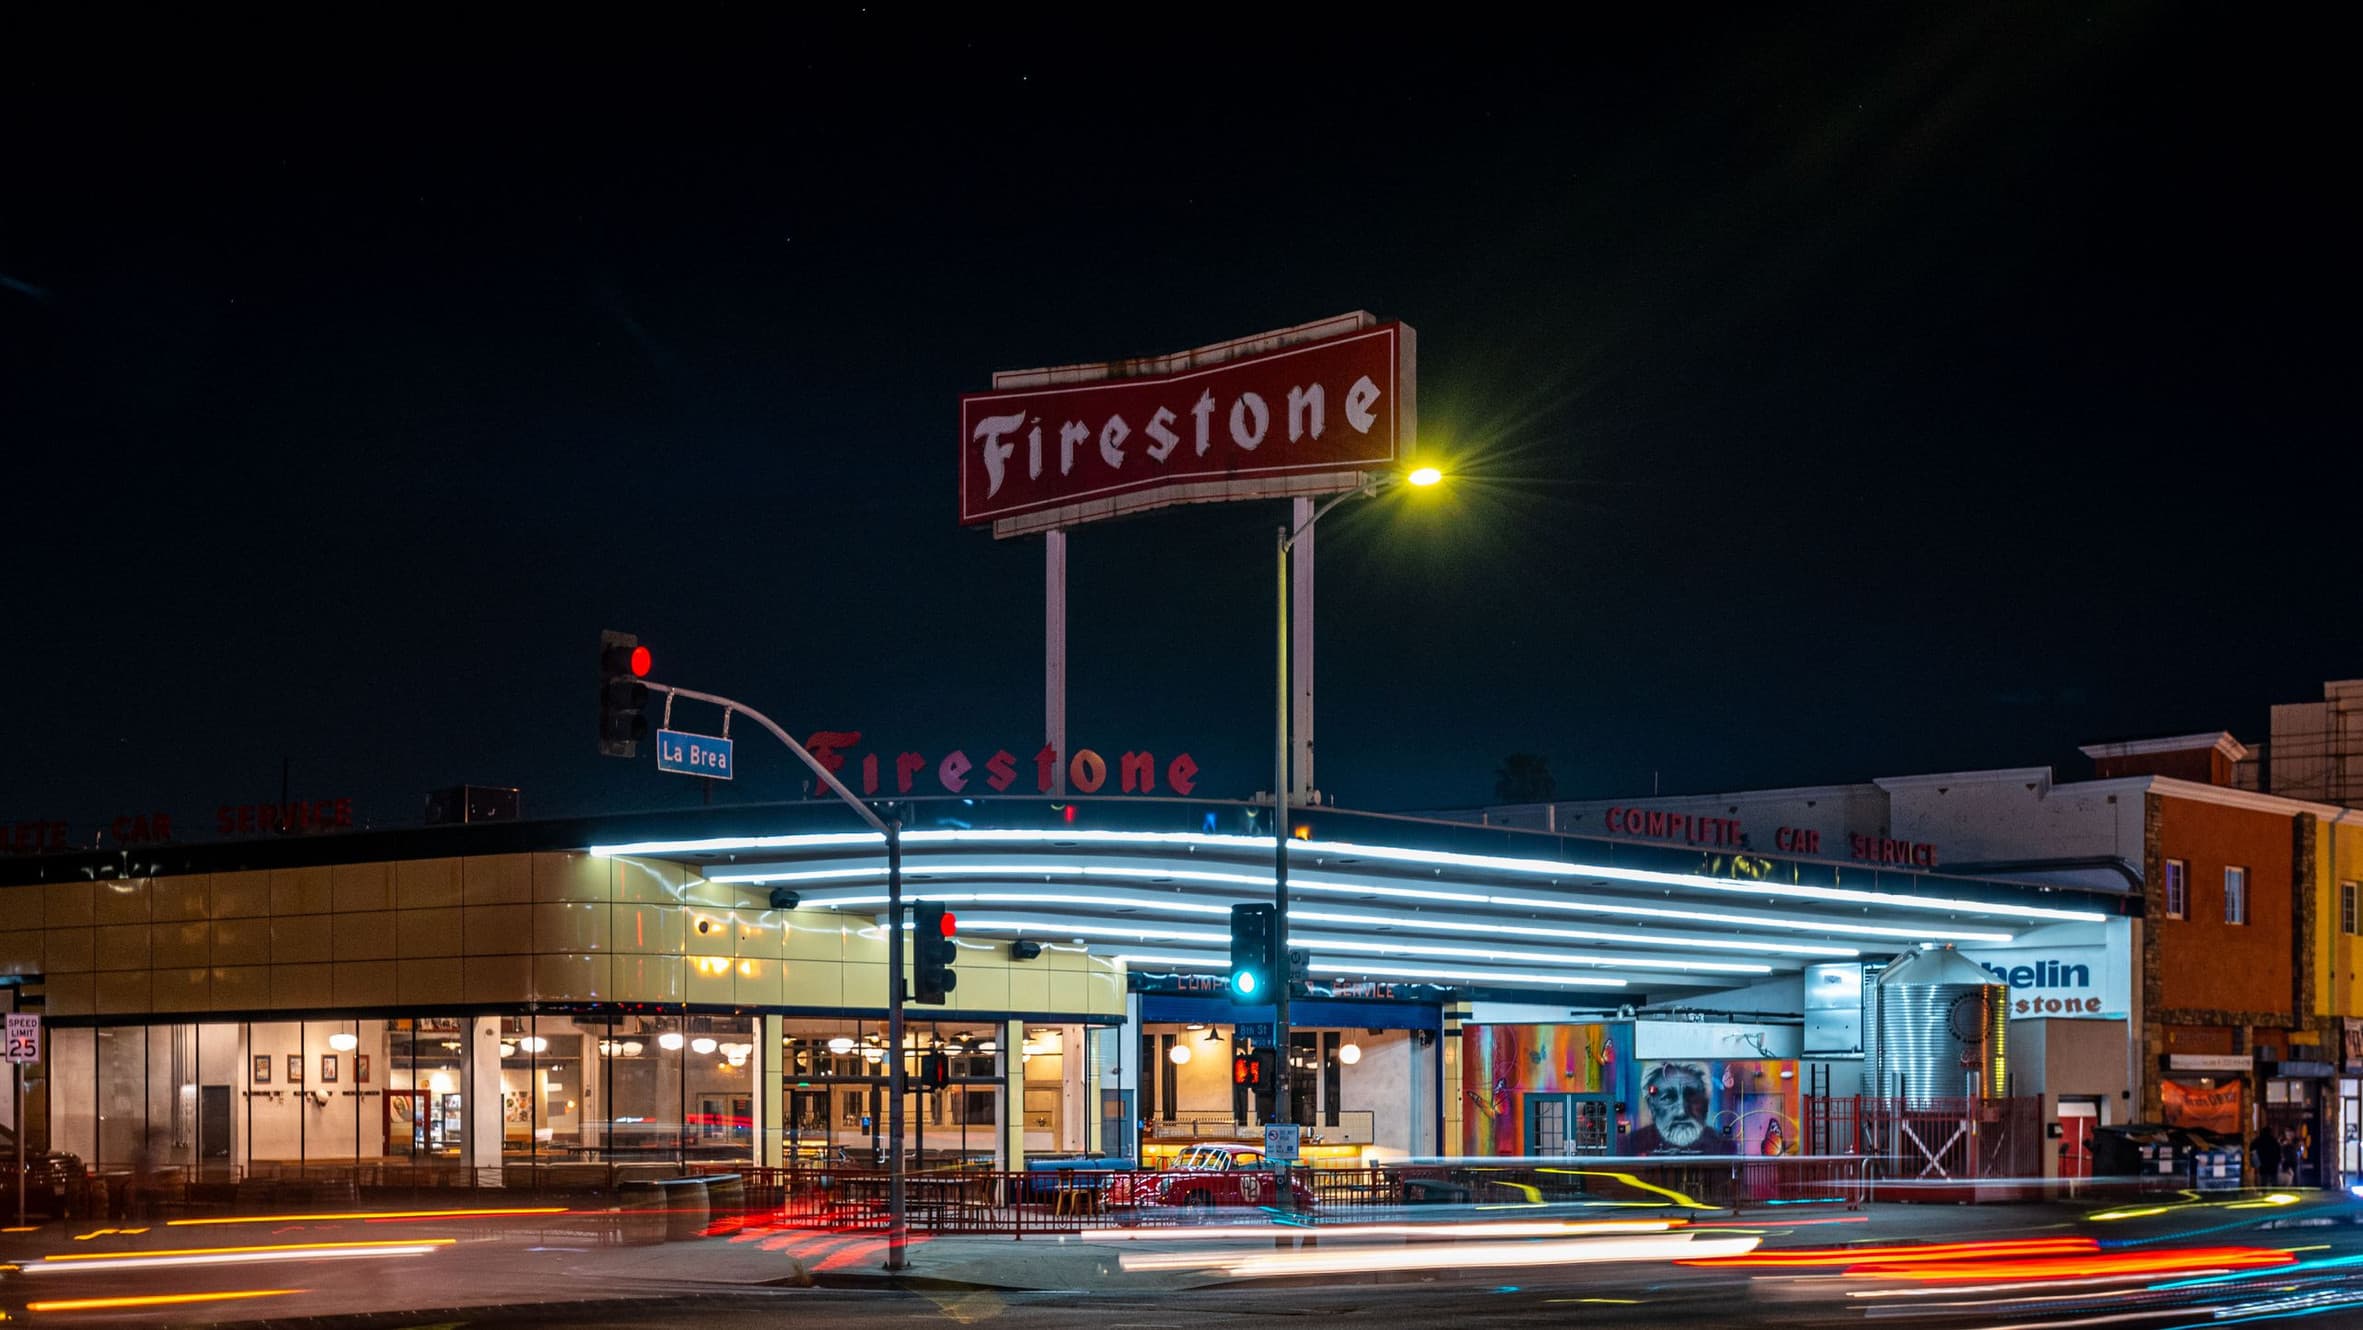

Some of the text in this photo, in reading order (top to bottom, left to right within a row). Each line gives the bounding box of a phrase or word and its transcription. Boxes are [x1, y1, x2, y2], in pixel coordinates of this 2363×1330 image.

[973, 374, 1382, 500] Firestone
[663, 740, 727, 769] La Brea
[803, 731, 1200, 797] Firestone
[110, 810, 174, 842] CAR
[215, 796, 353, 834] SERVICE
[1603, 806, 1940, 867] COMPLETE CAR SERVICE
[2010, 994, 2103, 1014] stone
[8, 1018, 38, 1028] SPEED
[11, 1029, 34, 1038] LIMIT
[9, 1039, 36, 1058] 25
